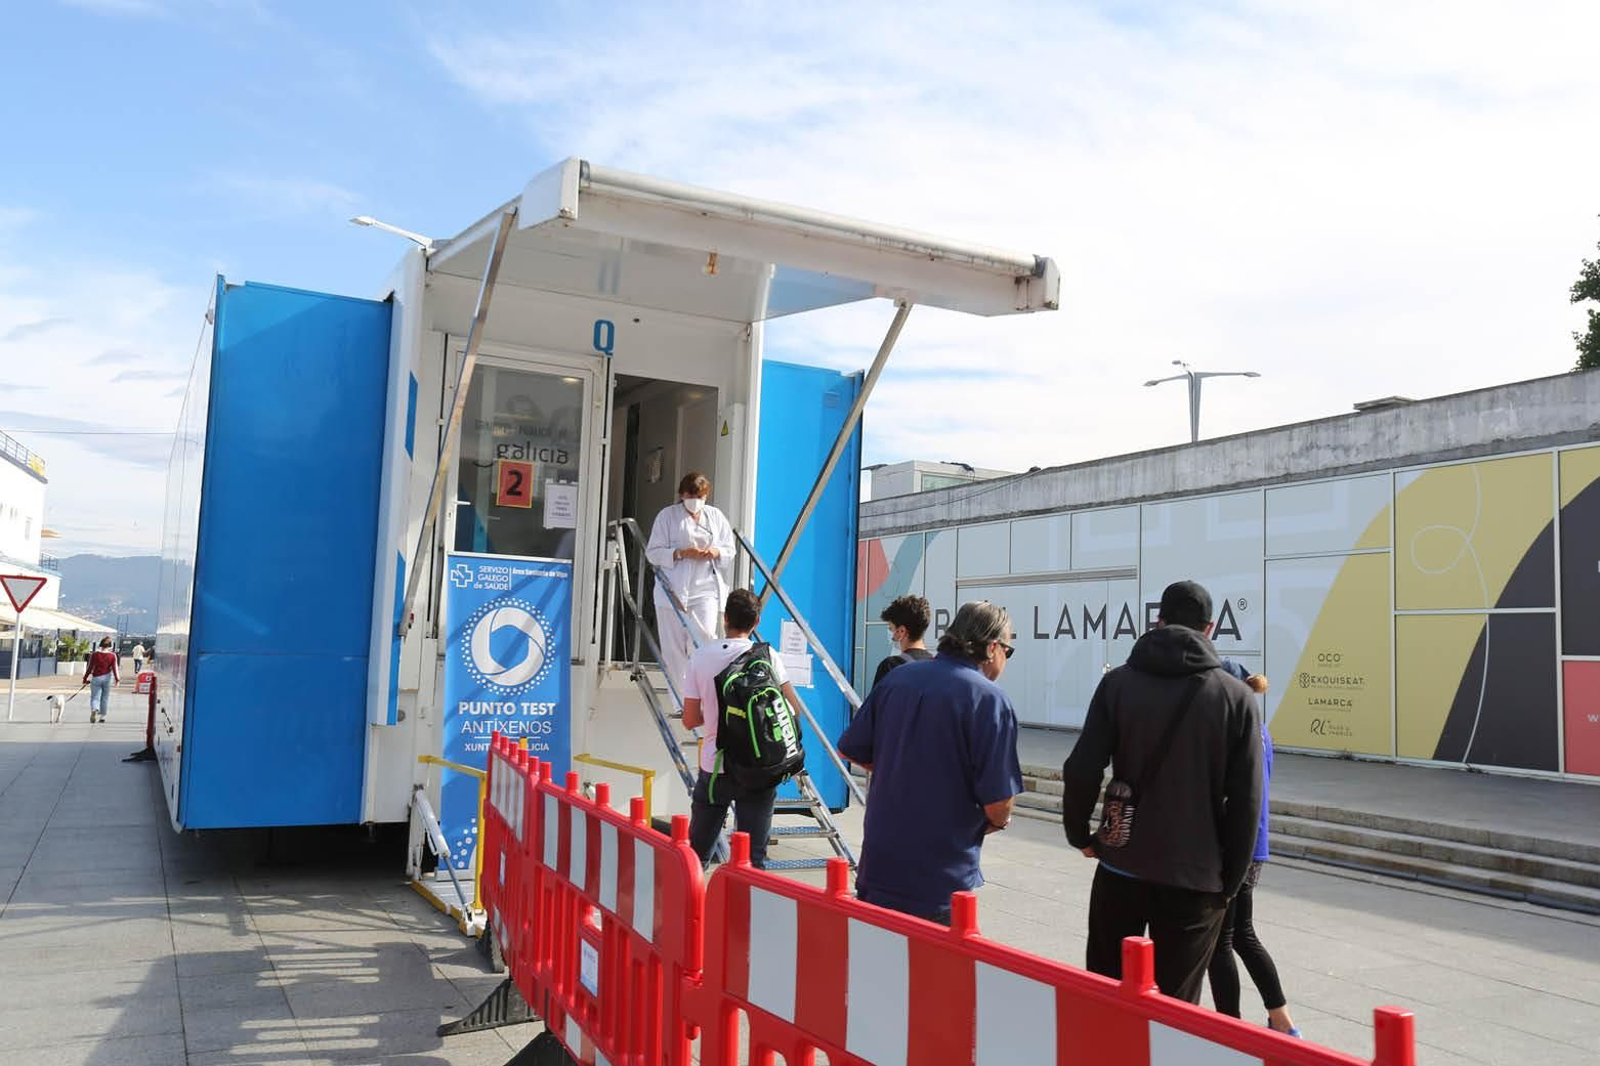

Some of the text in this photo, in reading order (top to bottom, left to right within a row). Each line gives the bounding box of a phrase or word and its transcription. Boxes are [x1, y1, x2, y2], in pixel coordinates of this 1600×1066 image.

[497, 441, 569, 465] galicia
[506, 470, 522, 496] 2
[479, 565, 509, 574] SERVIZO
[478, 574, 509, 582] GALEGO
[1317, 653, 1341, 662] OCO
[1308, 698, 1352, 706] LAMARCA
[458, 701, 556, 716] PUNTO TEST
[461, 718, 552, 734] ANTÍXENOS
[772, 699, 798, 758] arena
[465, 743, 491, 751] XUNT
